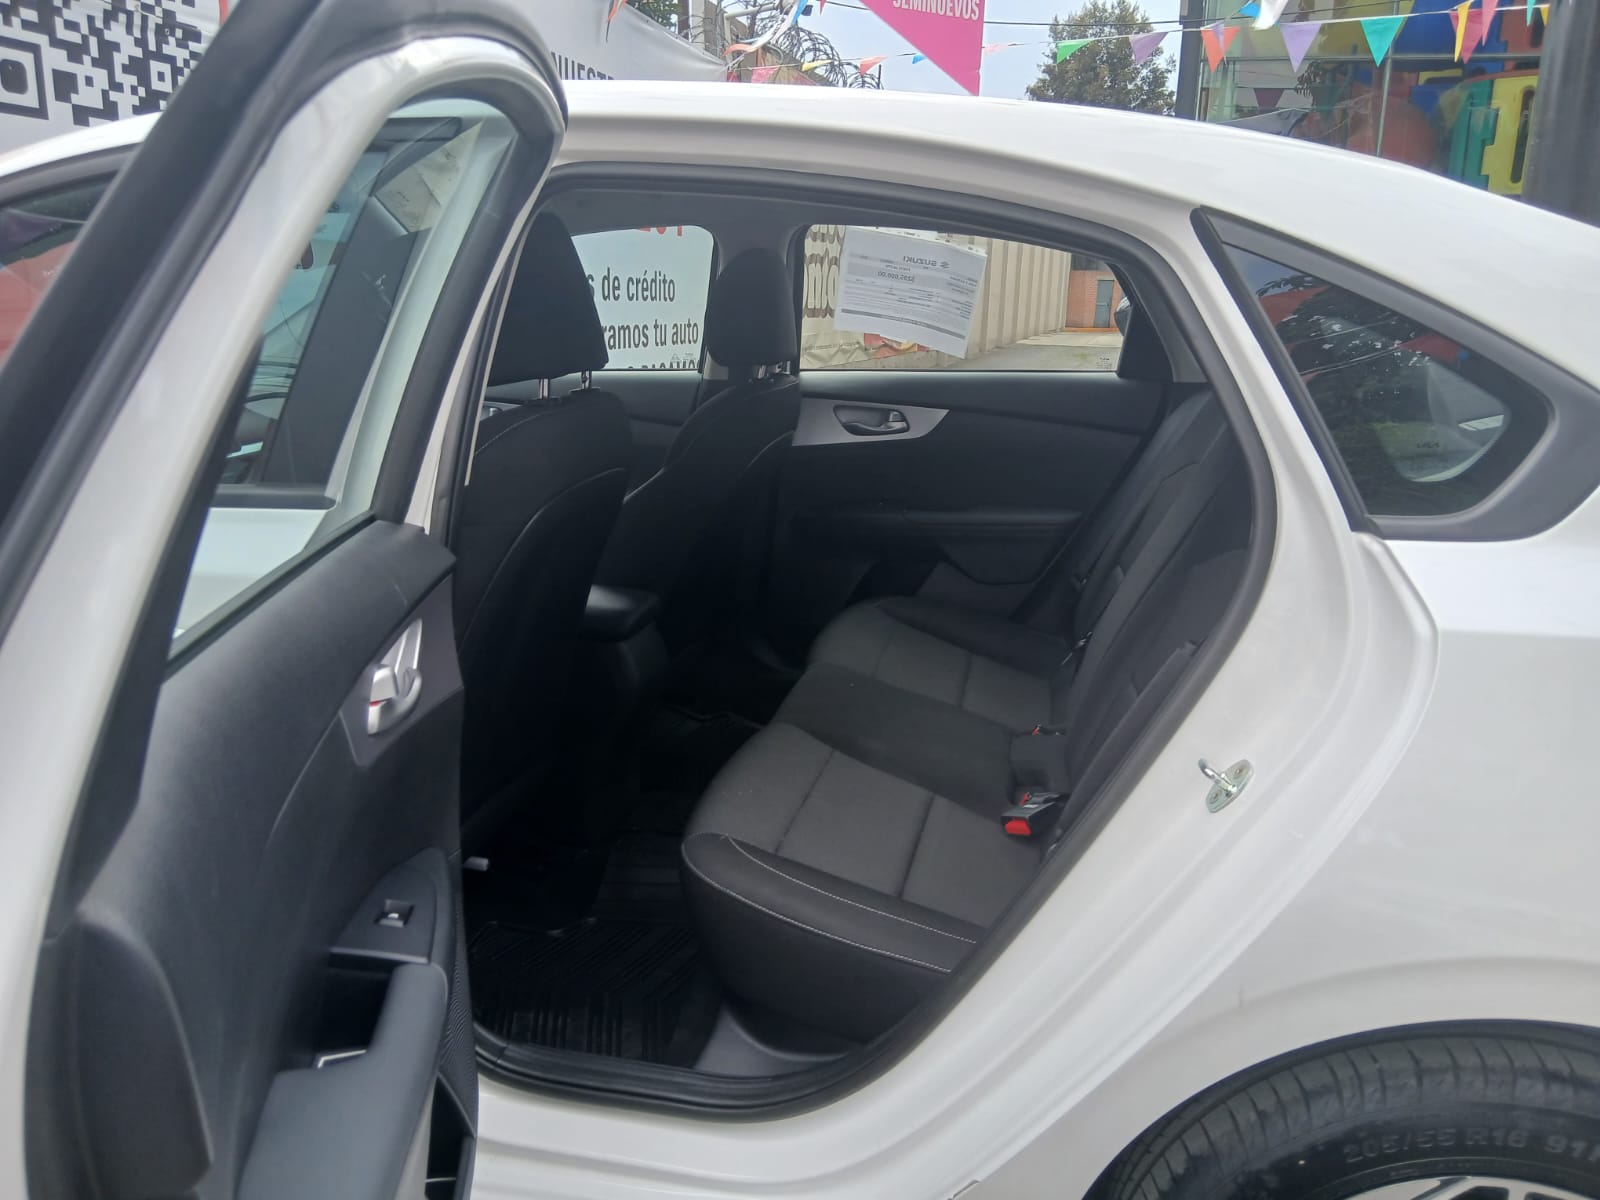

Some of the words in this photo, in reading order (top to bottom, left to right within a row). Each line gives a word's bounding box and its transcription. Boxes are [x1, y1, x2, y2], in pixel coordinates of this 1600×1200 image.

[602, 267, 621, 301] de
[627, 269, 675, 302] crédito
[653, 319, 667, 346] tu
[671, 318, 699, 346] auto
[1343, 1127, 1457, 1163] 205/55
[1465, 1127, 1529, 1149] R16
